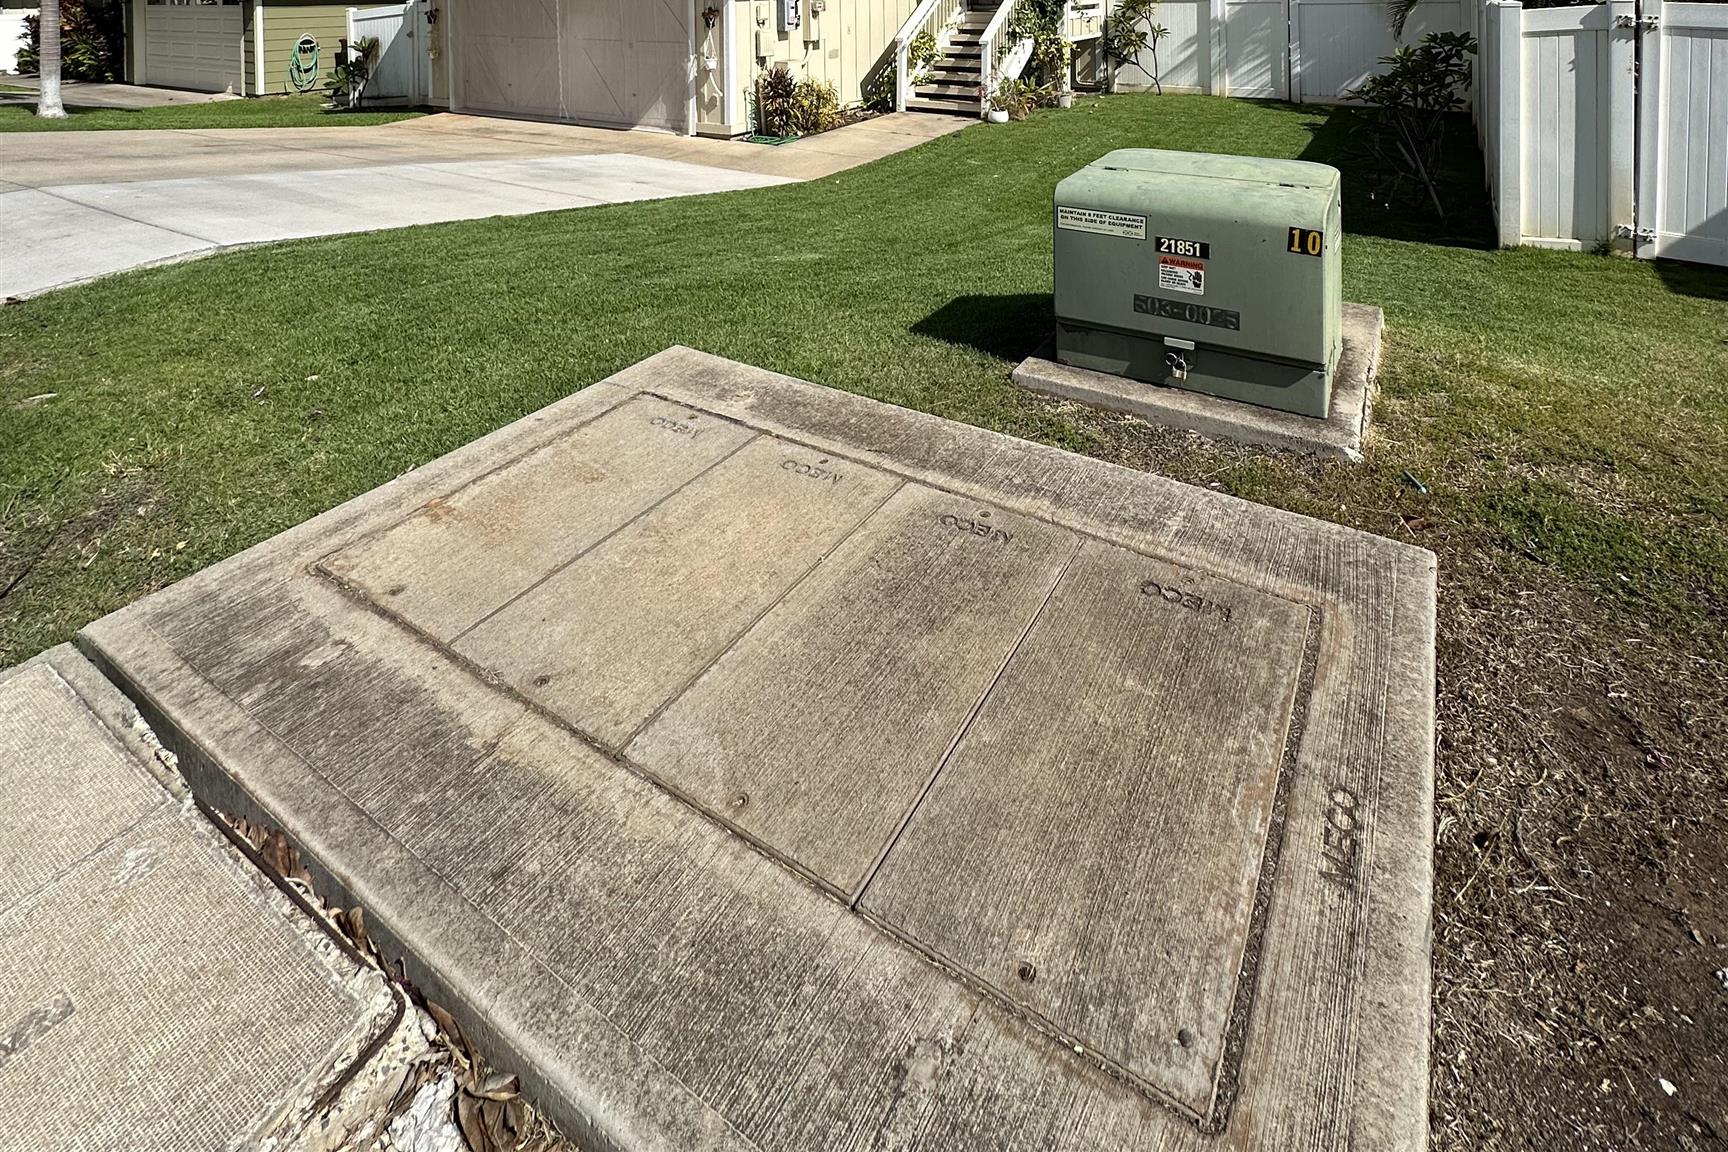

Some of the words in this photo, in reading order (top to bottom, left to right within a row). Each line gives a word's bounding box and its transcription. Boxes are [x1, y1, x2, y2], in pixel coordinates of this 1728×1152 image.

[1059, 208, 1087, 216] MAINTAIN
[1108, 213, 1144, 224] CLEARANCE
[1108, 221, 1143, 230] EQUIPMENT
[1160, 238, 1200, 257] 21851
[1290, 229, 1321, 255] 10
[1168, 258, 1204, 270] WARNING
[1134, 295, 1238, 329] 503-005
[939, 514, 1013, 544] MECO
[1140, 579, 1232, 623] MECO
